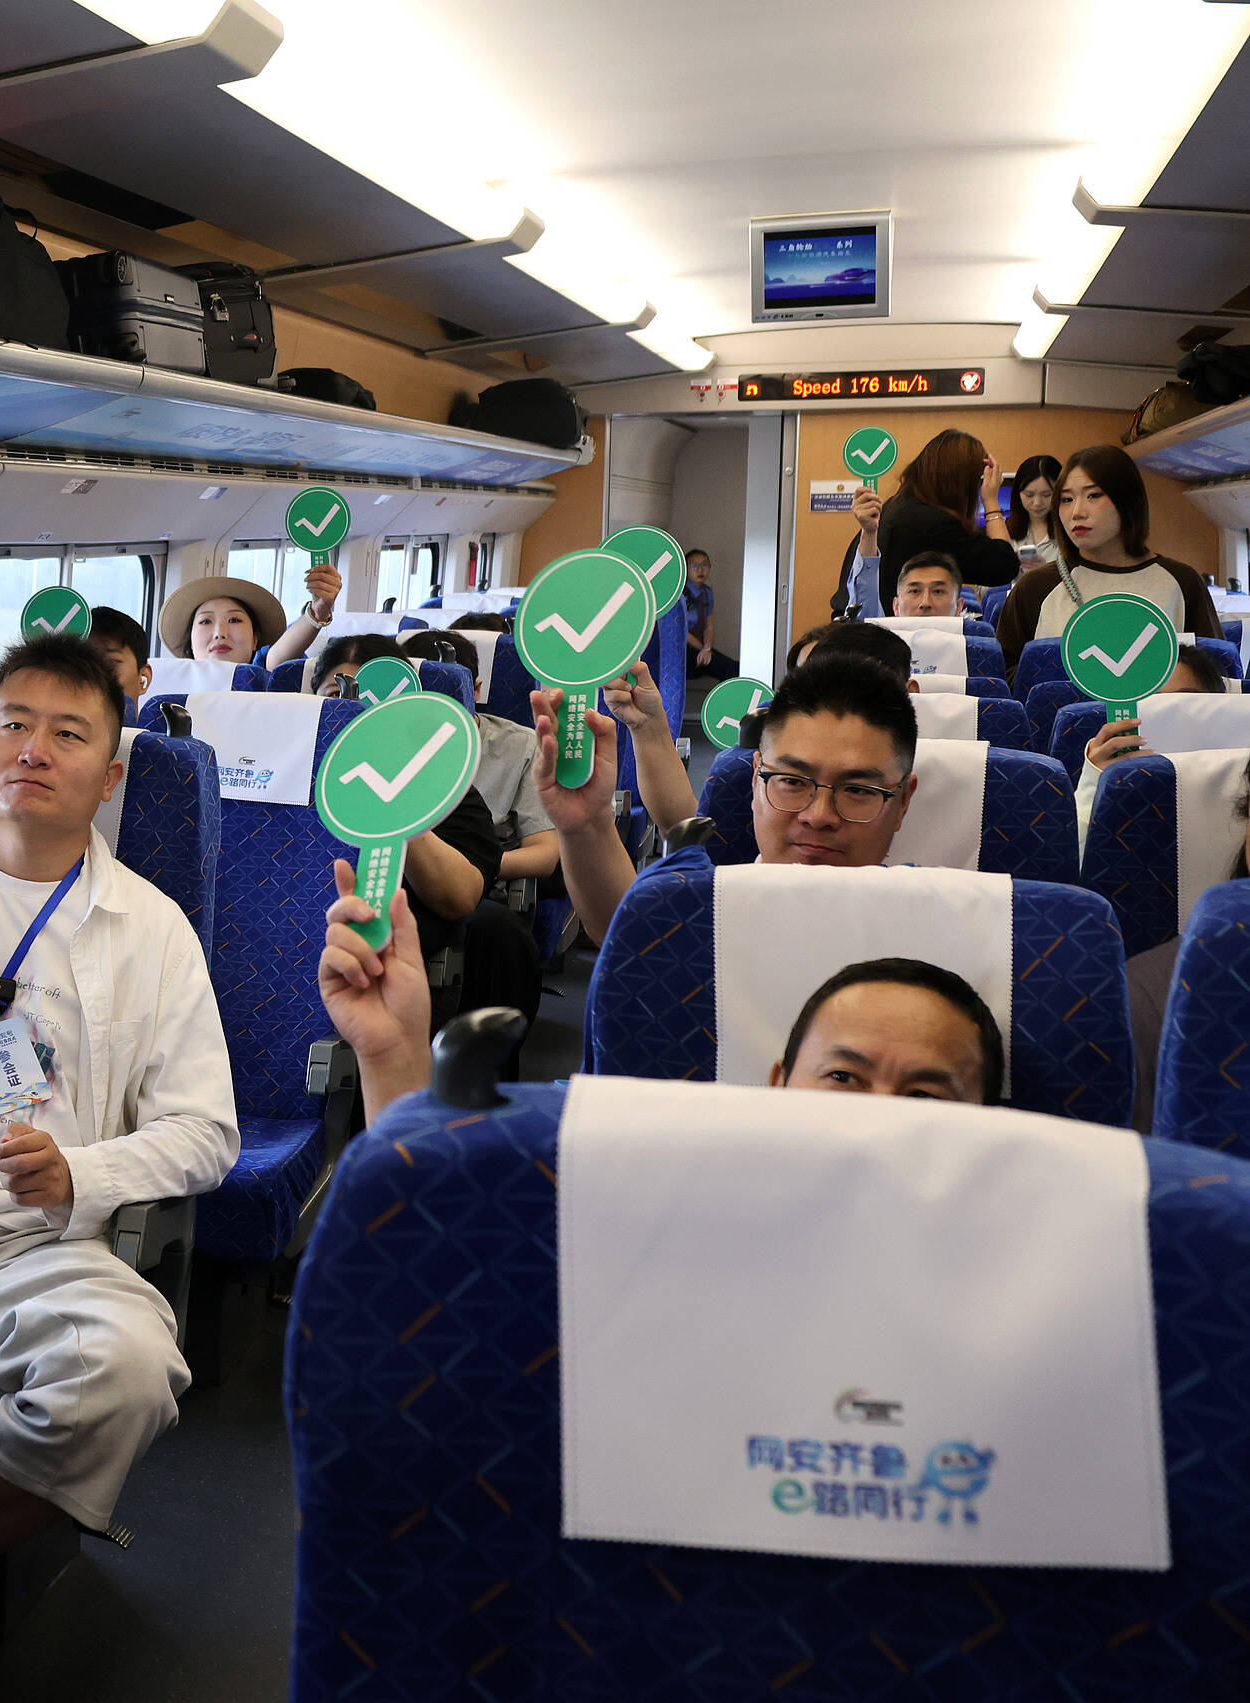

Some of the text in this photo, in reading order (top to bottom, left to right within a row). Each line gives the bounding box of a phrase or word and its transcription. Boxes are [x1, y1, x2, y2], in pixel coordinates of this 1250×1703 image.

[793, 373, 929, 398] Speed 176 km/h
[746, 1434, 908, 1479] 网安齐鲁
